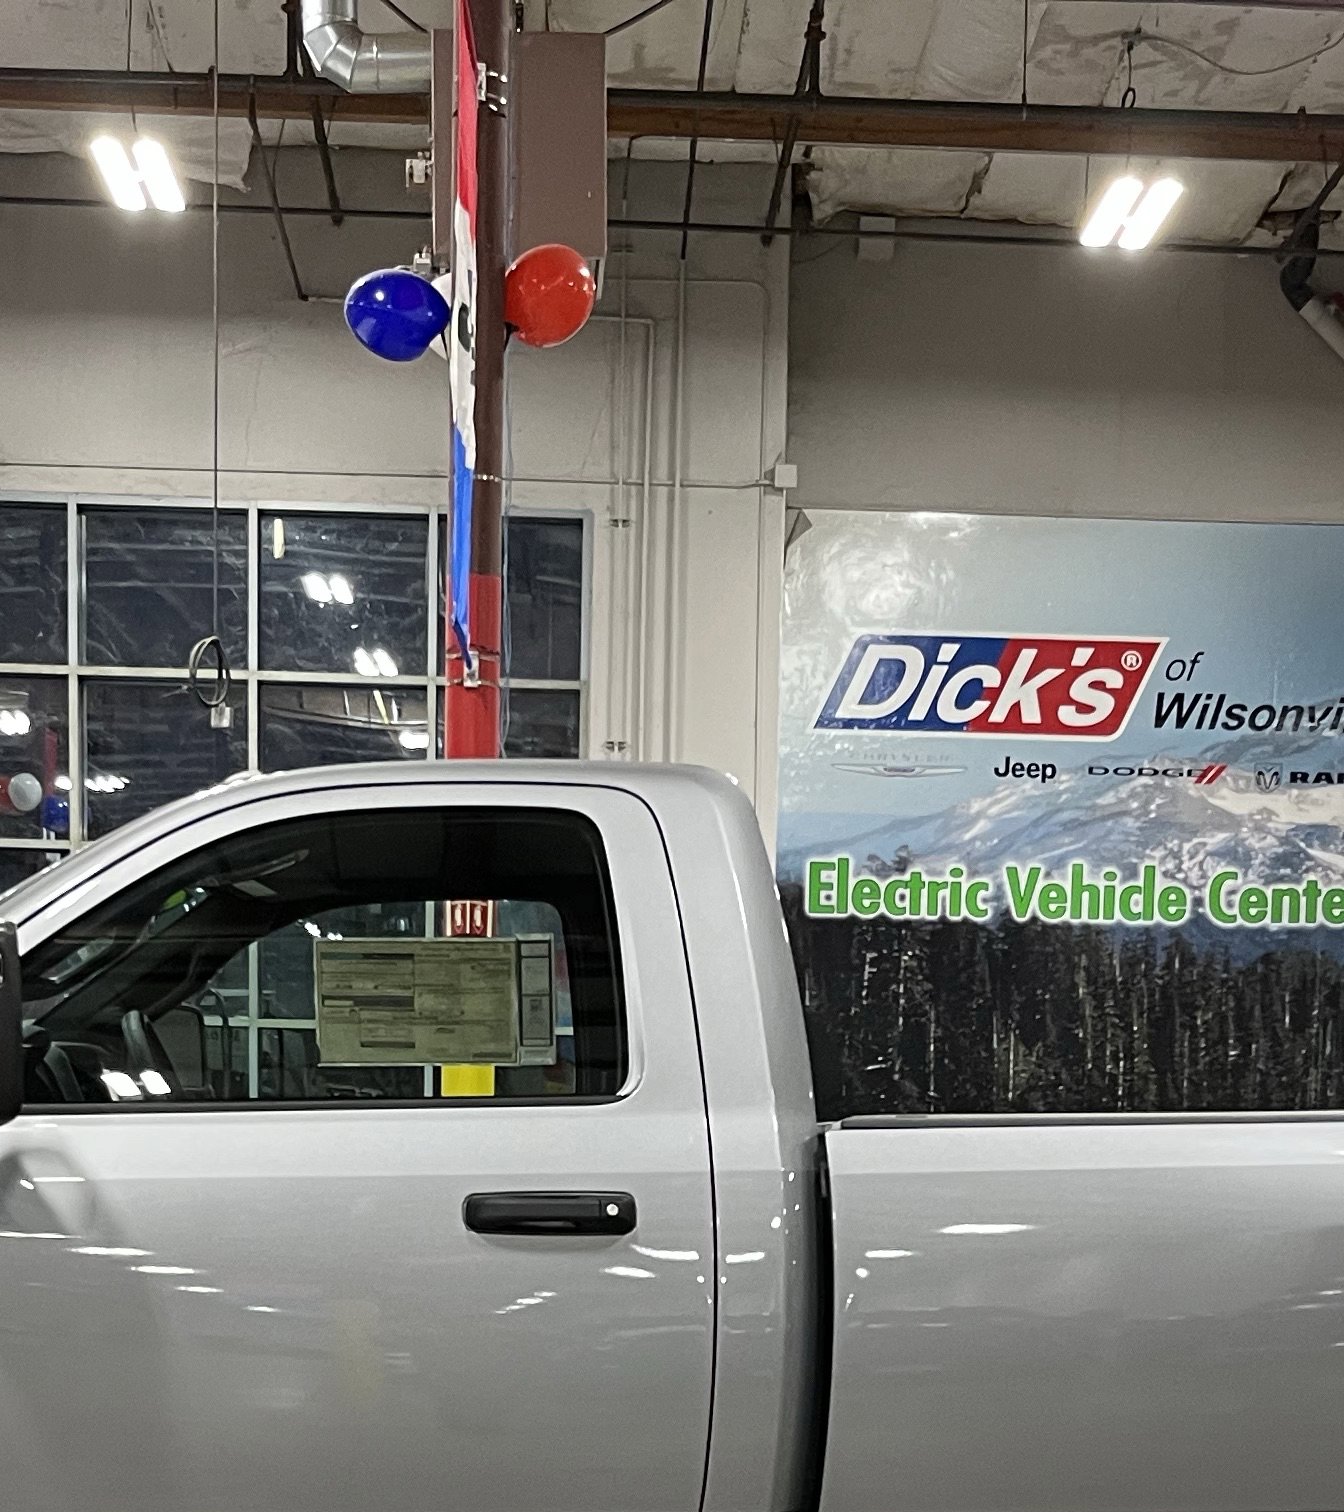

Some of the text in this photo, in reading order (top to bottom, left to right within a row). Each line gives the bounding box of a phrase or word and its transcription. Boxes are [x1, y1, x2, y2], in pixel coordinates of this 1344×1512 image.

[835, 643, 1125, 728] Dick's
[1164, 651, 1205, 682] of
[993, 756, 1057, 783] Jeep
[808, 857, 989, 917] Electric
[1005, 863, 1188, 923] Vehicle
